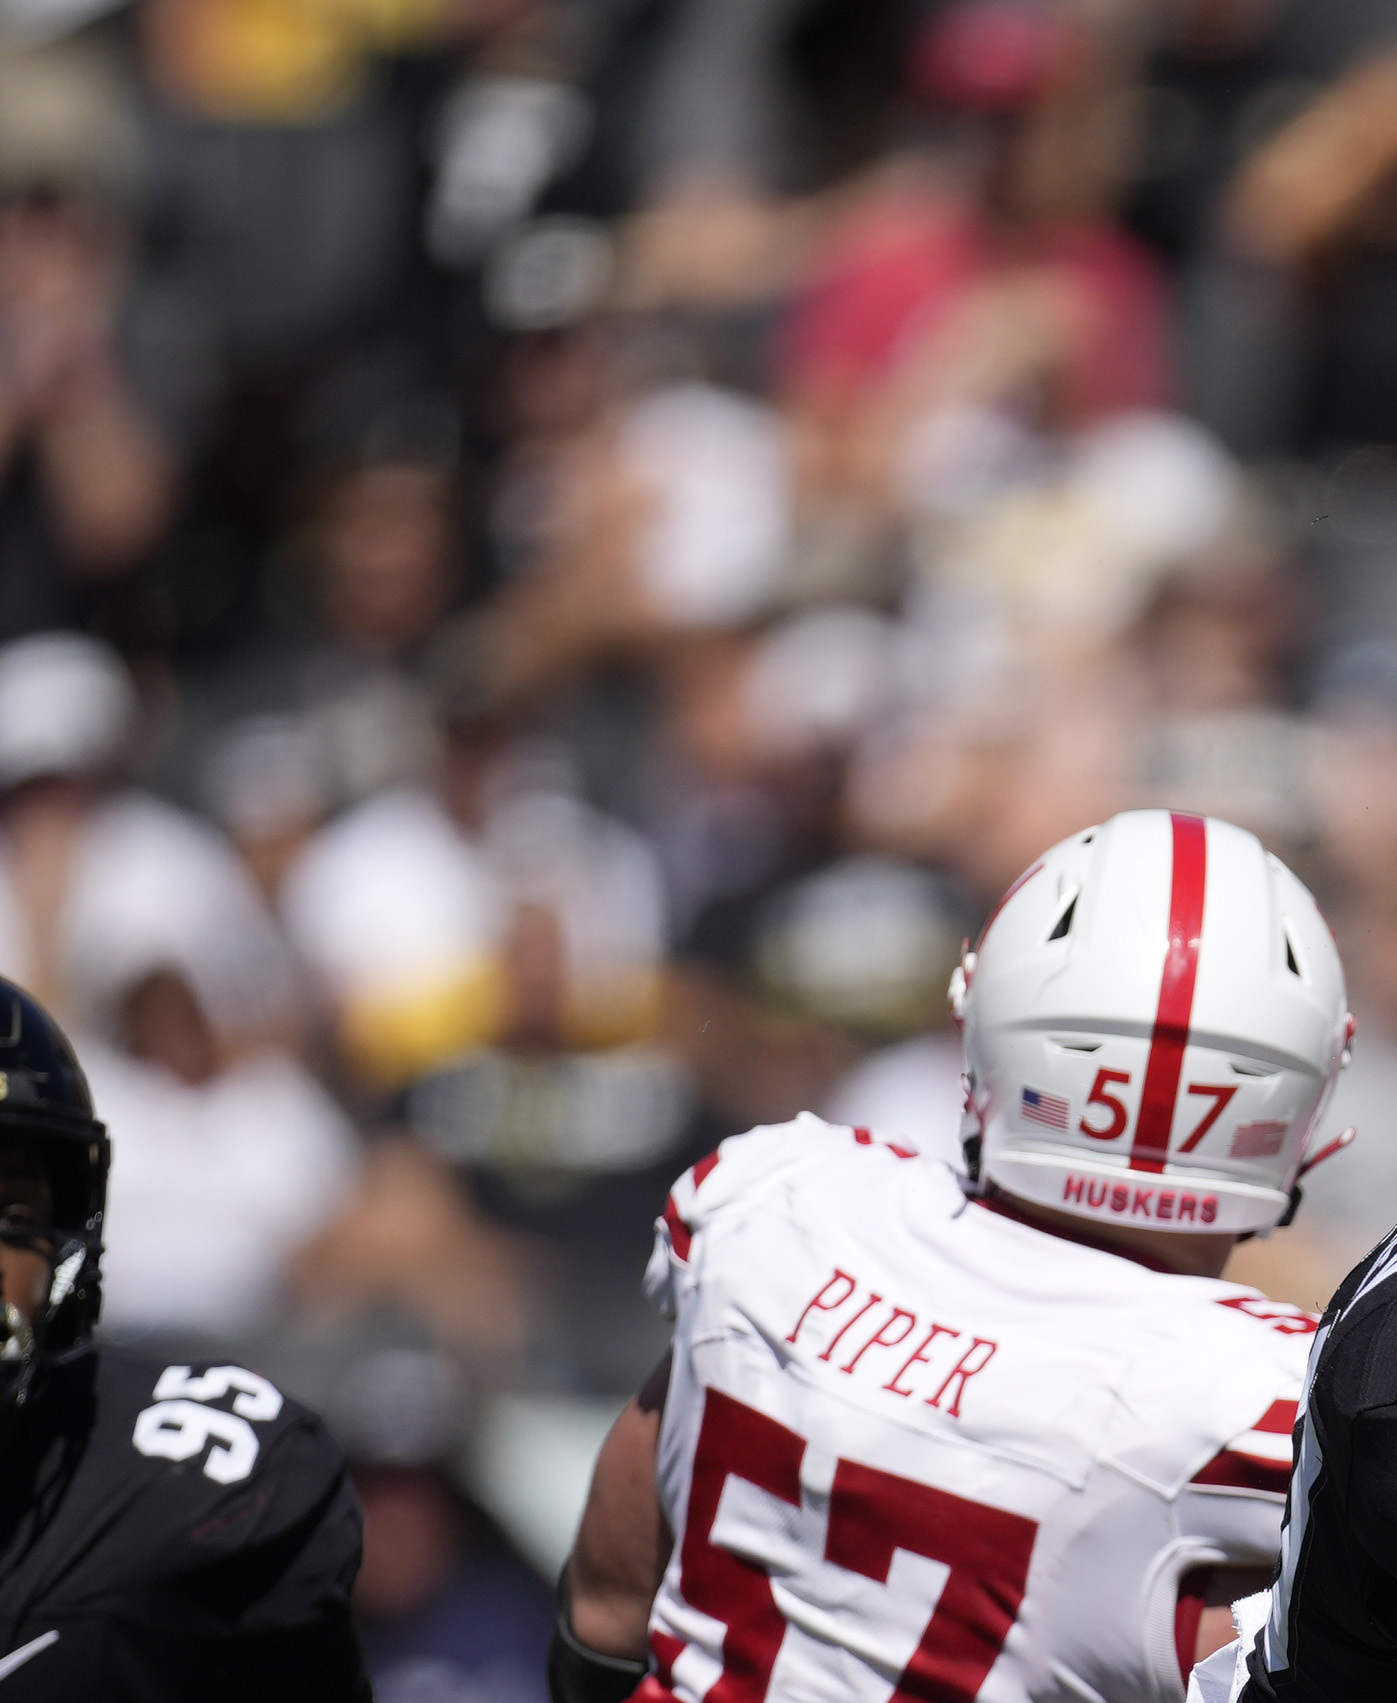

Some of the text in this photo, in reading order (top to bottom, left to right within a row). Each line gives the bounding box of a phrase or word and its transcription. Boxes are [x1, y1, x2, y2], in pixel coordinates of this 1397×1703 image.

[1077, 1067, 1239, 1153] 57
[1063, 1173, 1220, 1224] HUSKERS
[787, 1267, 999, 1419] PIPER
[132, 1364, 284, 1485] 95
